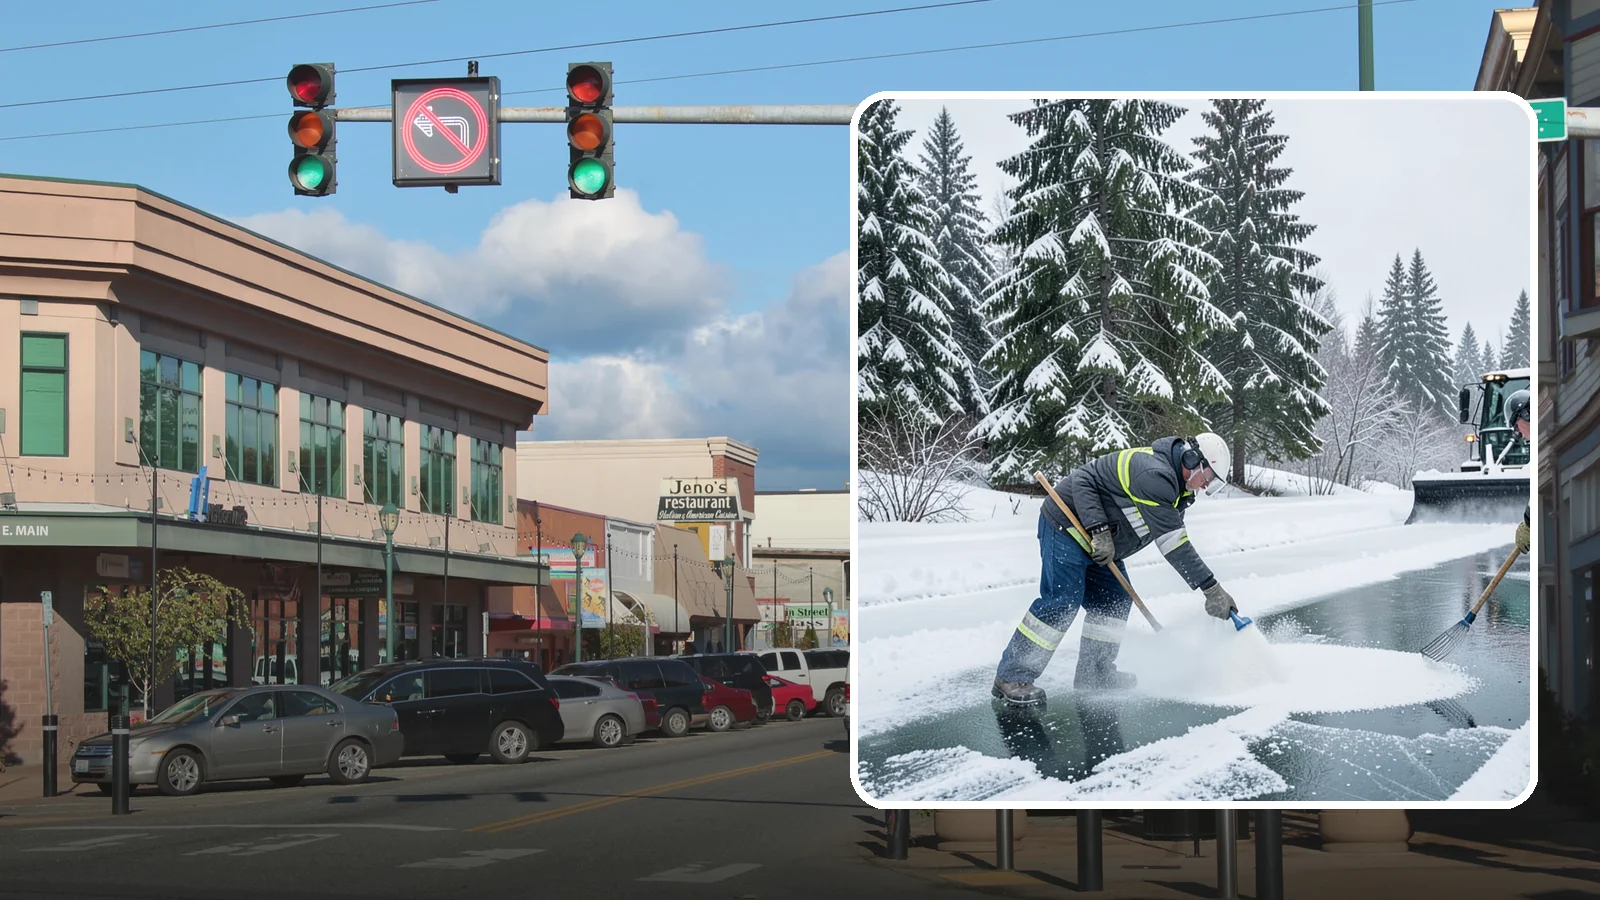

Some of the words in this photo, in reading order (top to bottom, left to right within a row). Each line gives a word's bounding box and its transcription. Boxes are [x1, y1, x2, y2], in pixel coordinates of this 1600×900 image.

[669, 479, 728, 495] Jeno's
[665, 496, 731, 509] restaurant
[658, 510, 682, 519] Italian
[685, 510, 714, 519] American
[714, 509, 738, 519] Cuisine
[2, 525, 13, 536] E.
[15, 525, 49, 536] MAIN
[797, 607, 828, 616] Street
